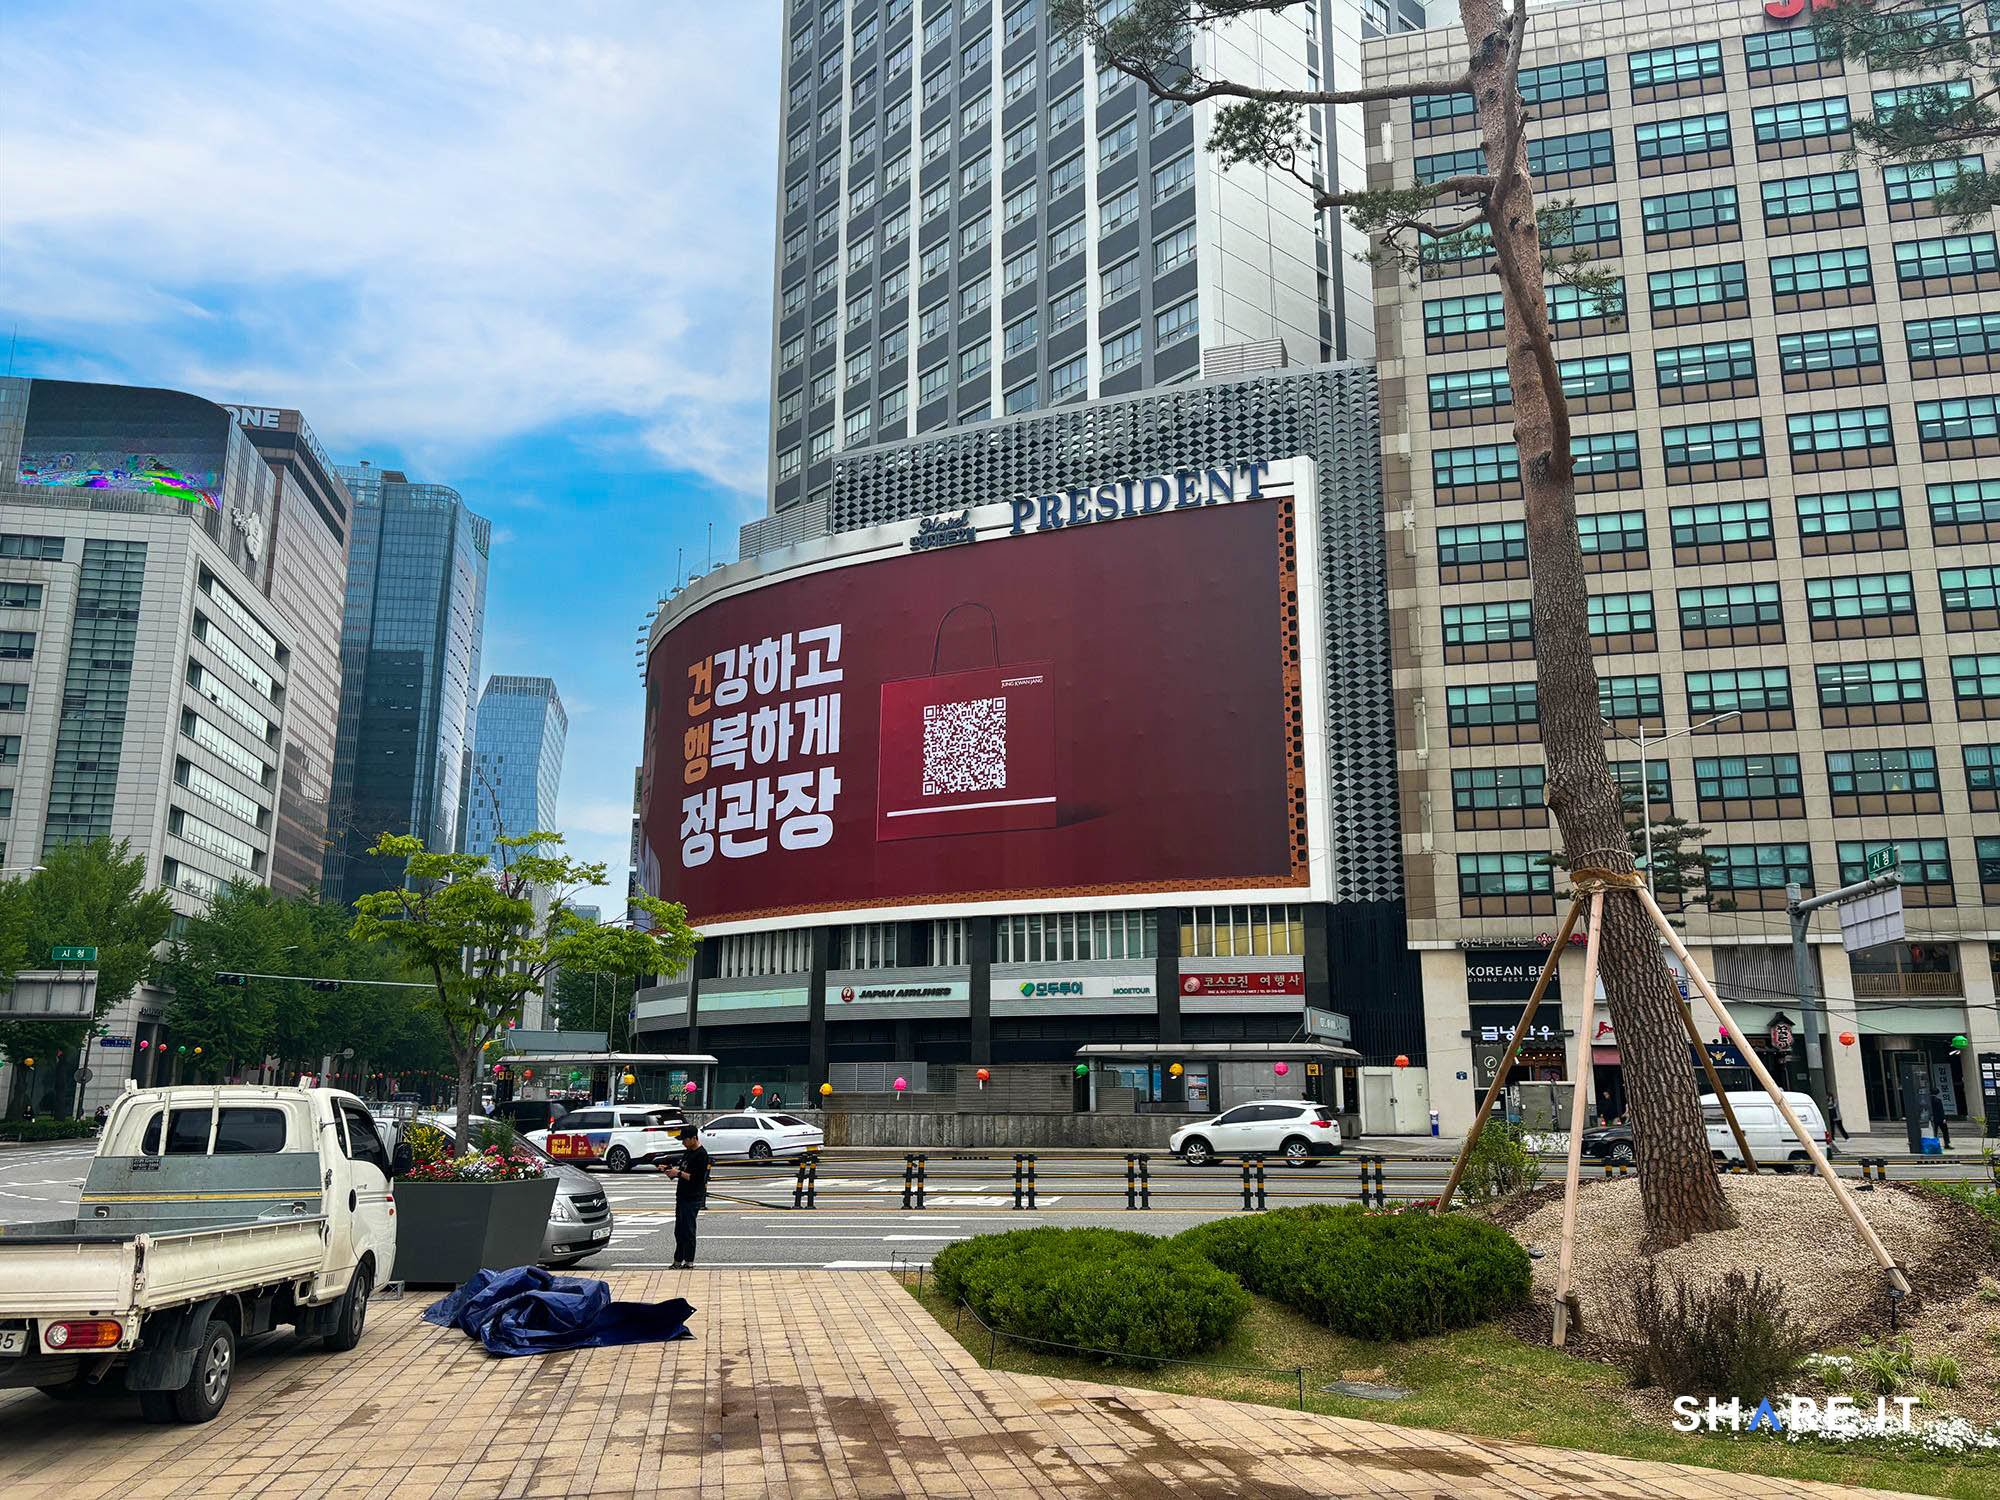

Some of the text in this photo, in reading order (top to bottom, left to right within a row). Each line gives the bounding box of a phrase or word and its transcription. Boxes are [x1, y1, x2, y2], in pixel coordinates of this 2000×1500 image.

[1010, 460, 1269, 534] PRESIDENT
[918, 509, 970, 535] Hotel
[688, 624, 843, 717] 건강하고
[684, 693, 842, 785] 행복하게
[680, 767, 842, 868] 정관장
[1872, 850, 1890, 869] 시청
[61, 949, 85, 958] 시청
[1467, 966, 1523, 977] KOREAN
[1036, 982, 1084, 997] 모두투어
[1204, 974, 1301, 989] 코스모진 여행사
[859, 988, 952, 999] JAPAN AIRLINES
[1112, 987, 1151, 995] MODETOUR
